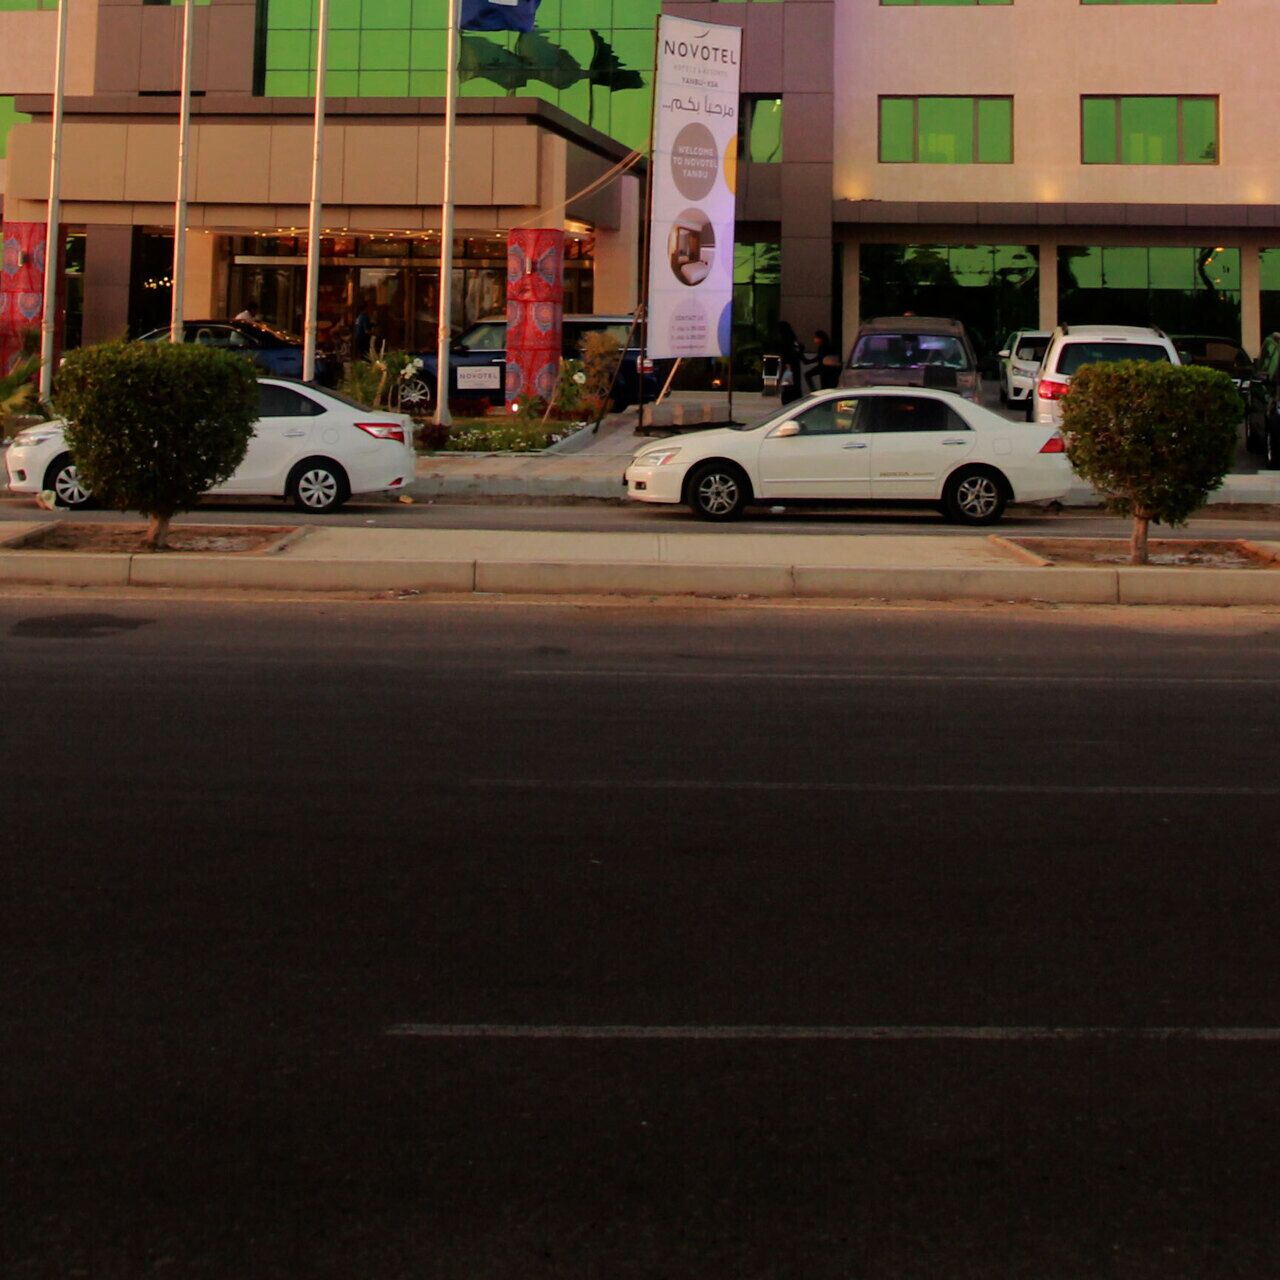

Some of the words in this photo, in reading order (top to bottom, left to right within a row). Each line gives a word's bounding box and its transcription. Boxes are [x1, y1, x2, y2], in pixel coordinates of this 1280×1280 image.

[664, 40, 737, 65] NOVOTEL
[679, 145, 713, 157] WELCOME
[673, 156, 683, 165] TO
[684, 158, 719, 169] NOVOTEL
